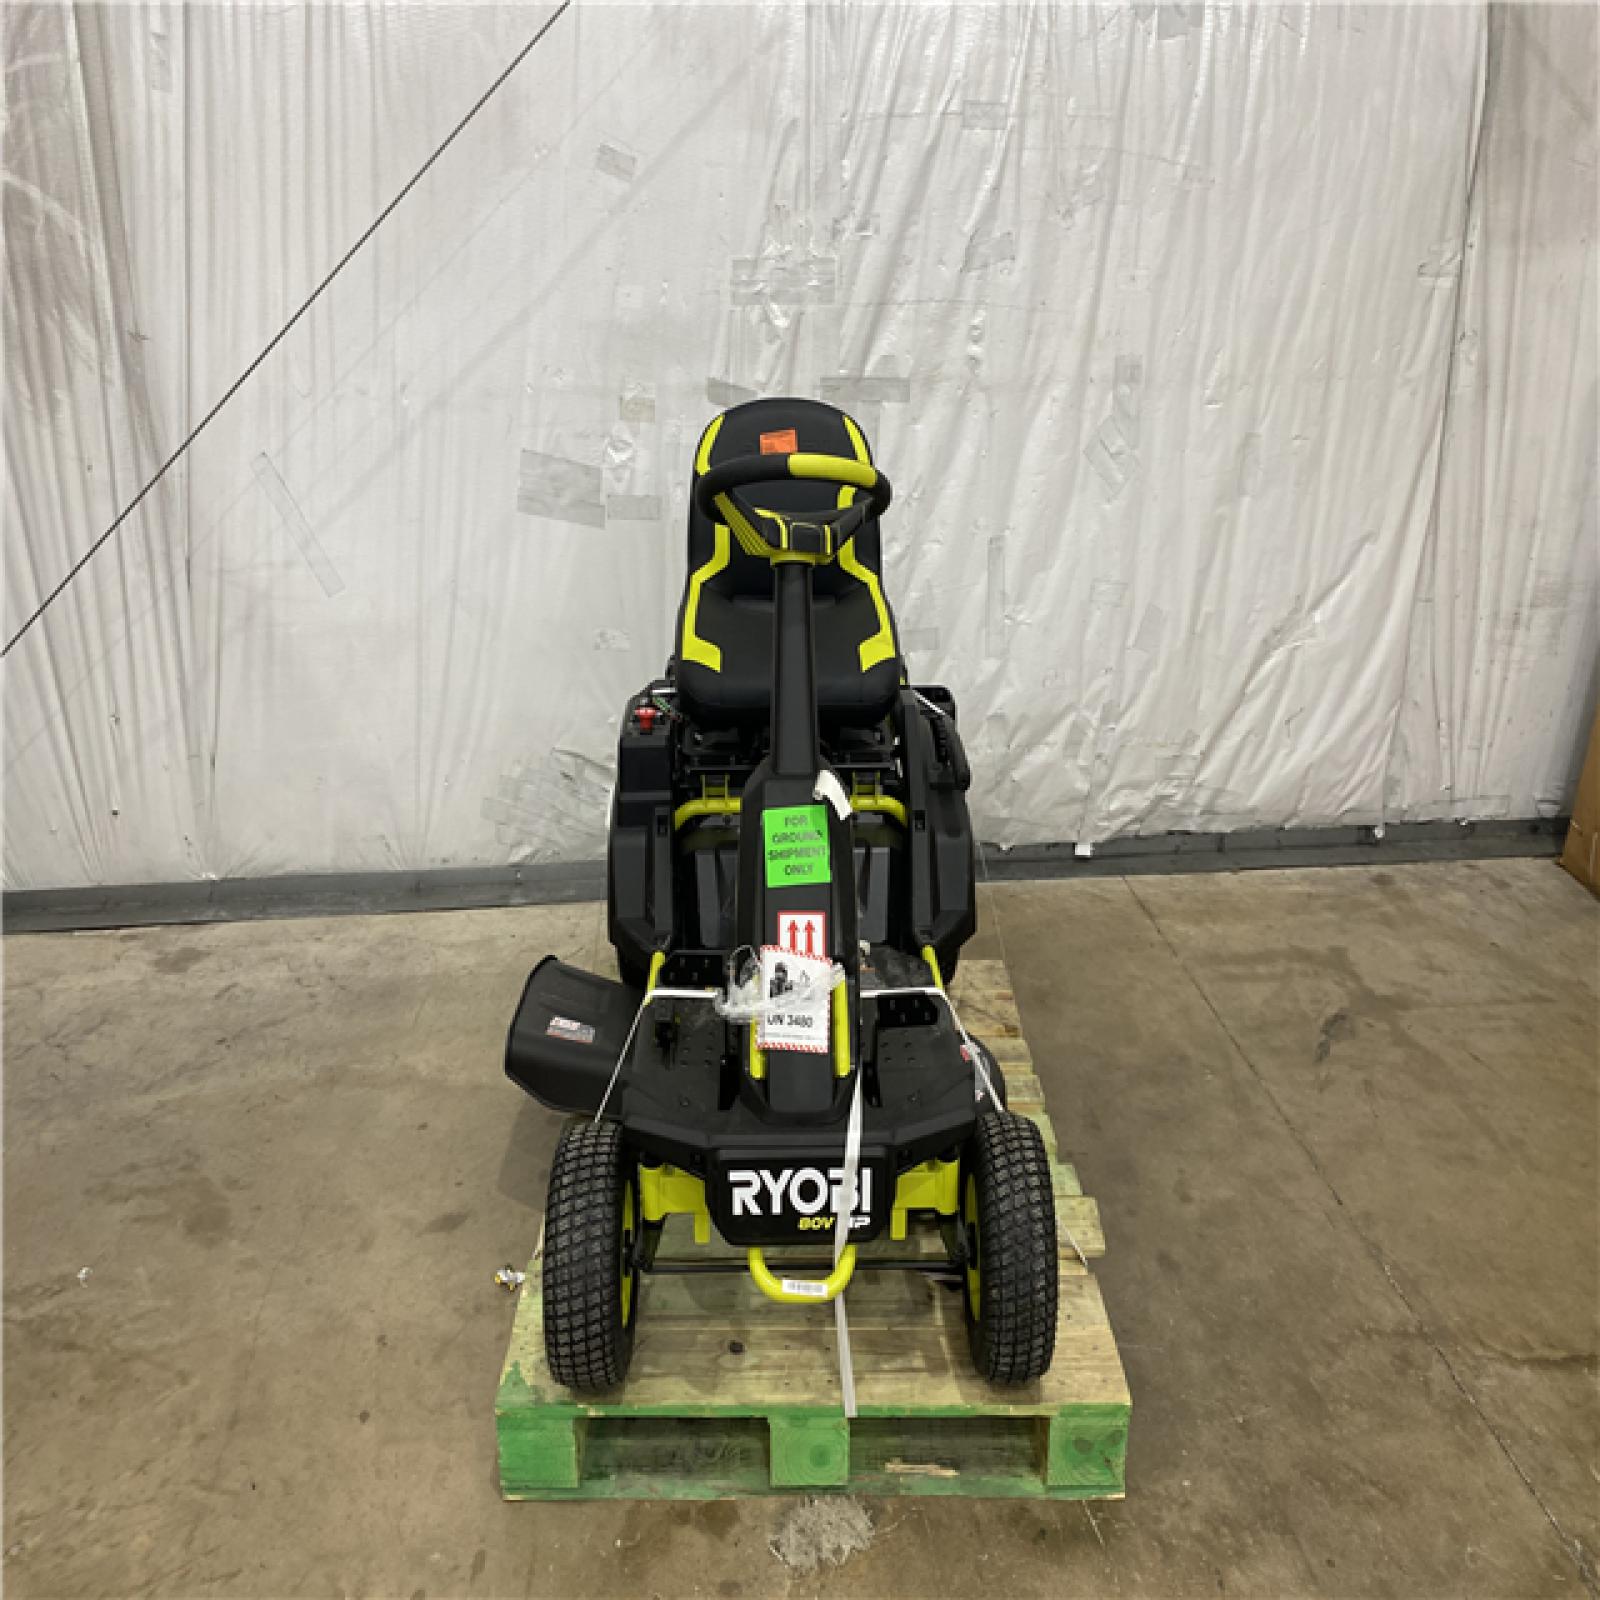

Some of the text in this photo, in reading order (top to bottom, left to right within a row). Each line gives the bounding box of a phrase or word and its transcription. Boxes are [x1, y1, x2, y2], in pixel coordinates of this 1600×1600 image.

[785, 814, 808, 827] FOR
[768, 846, 826, 861] SHIPMENT
[784, 864, 813, 876] ONLY
